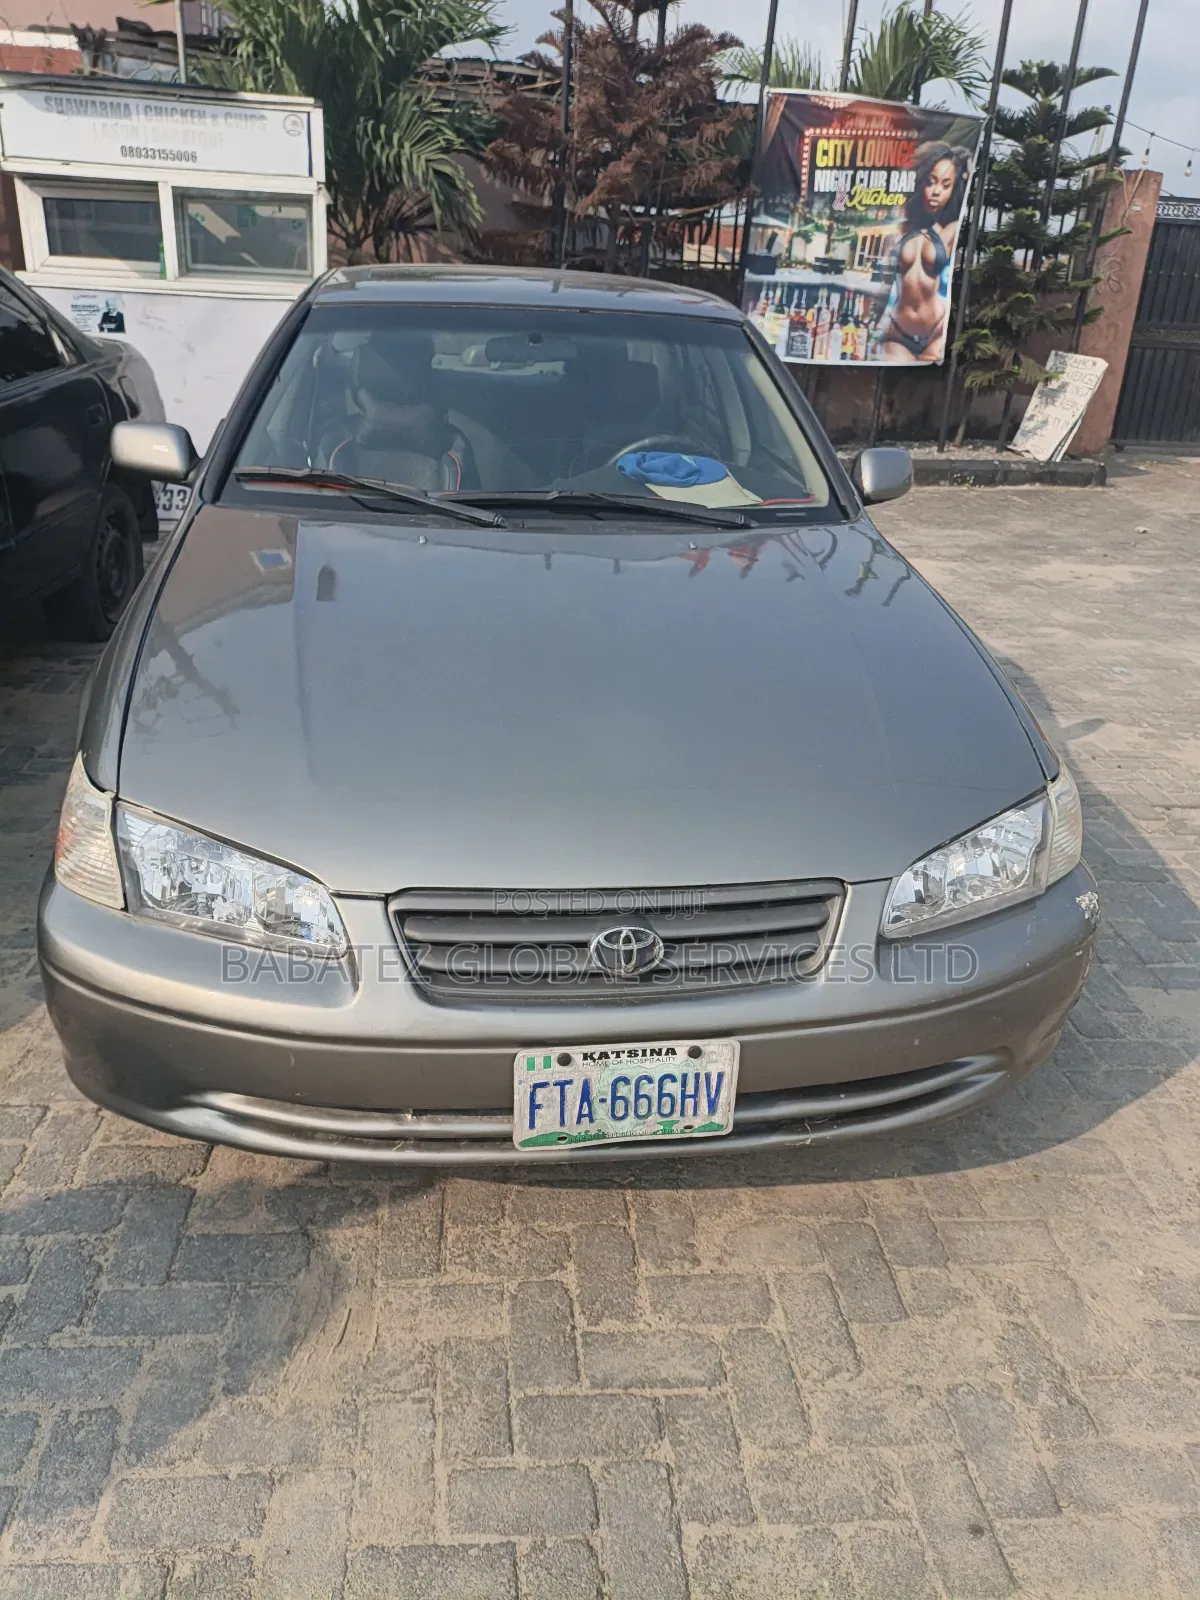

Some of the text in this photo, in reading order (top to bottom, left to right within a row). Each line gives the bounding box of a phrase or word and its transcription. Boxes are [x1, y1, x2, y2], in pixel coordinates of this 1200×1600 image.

[43, 95, 133, 121] SHAWARMA
[143, 104, 207, 126] CHICKEN
[815, 138, 854, 168] CITY
[813, 169, 917, 193] NIGHT CLUB BAR
[846, 184, 907, 212] Kitchen
[582, 1047, 677, 1061] KATSINA
[626, 1056, 676, 1064] HOSPITALITY
[528, 1071, 724, 1130] FTA-666HV
